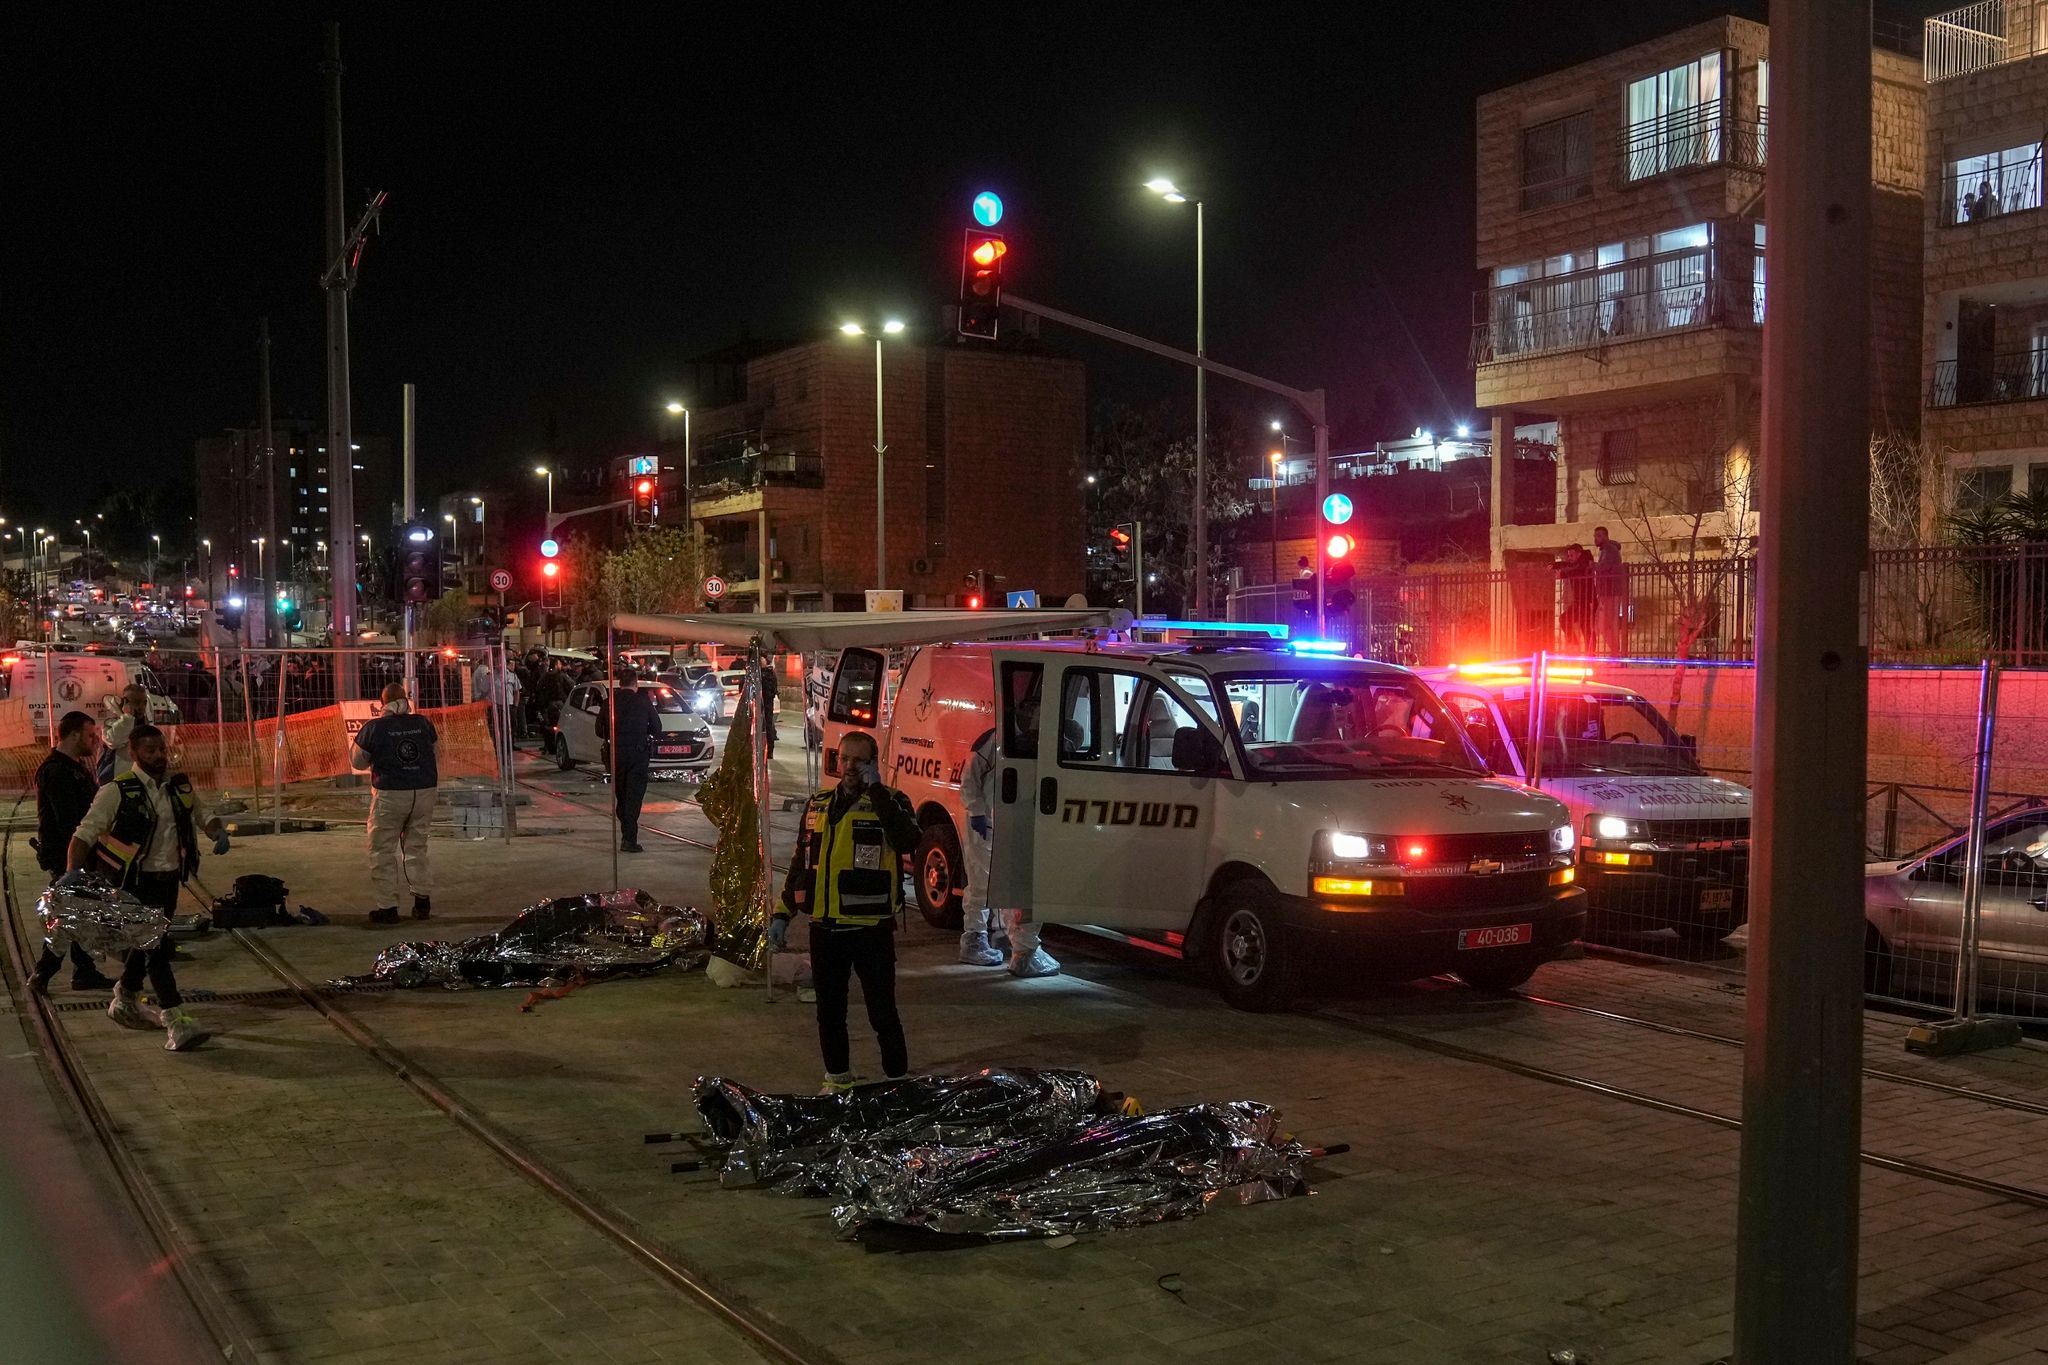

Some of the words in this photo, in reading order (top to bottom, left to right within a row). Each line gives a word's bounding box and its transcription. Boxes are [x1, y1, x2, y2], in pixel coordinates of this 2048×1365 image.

[495, 575, 508, 586] 30
[708, 582, 721, 592] 30
[896, 754, 942, 779] POLICE
[1639, 793, 1749, 806] AMBULANCE
[1062, 799, 1199, 829] משטרה
[1477, 927, 1520, 946] 40-036
